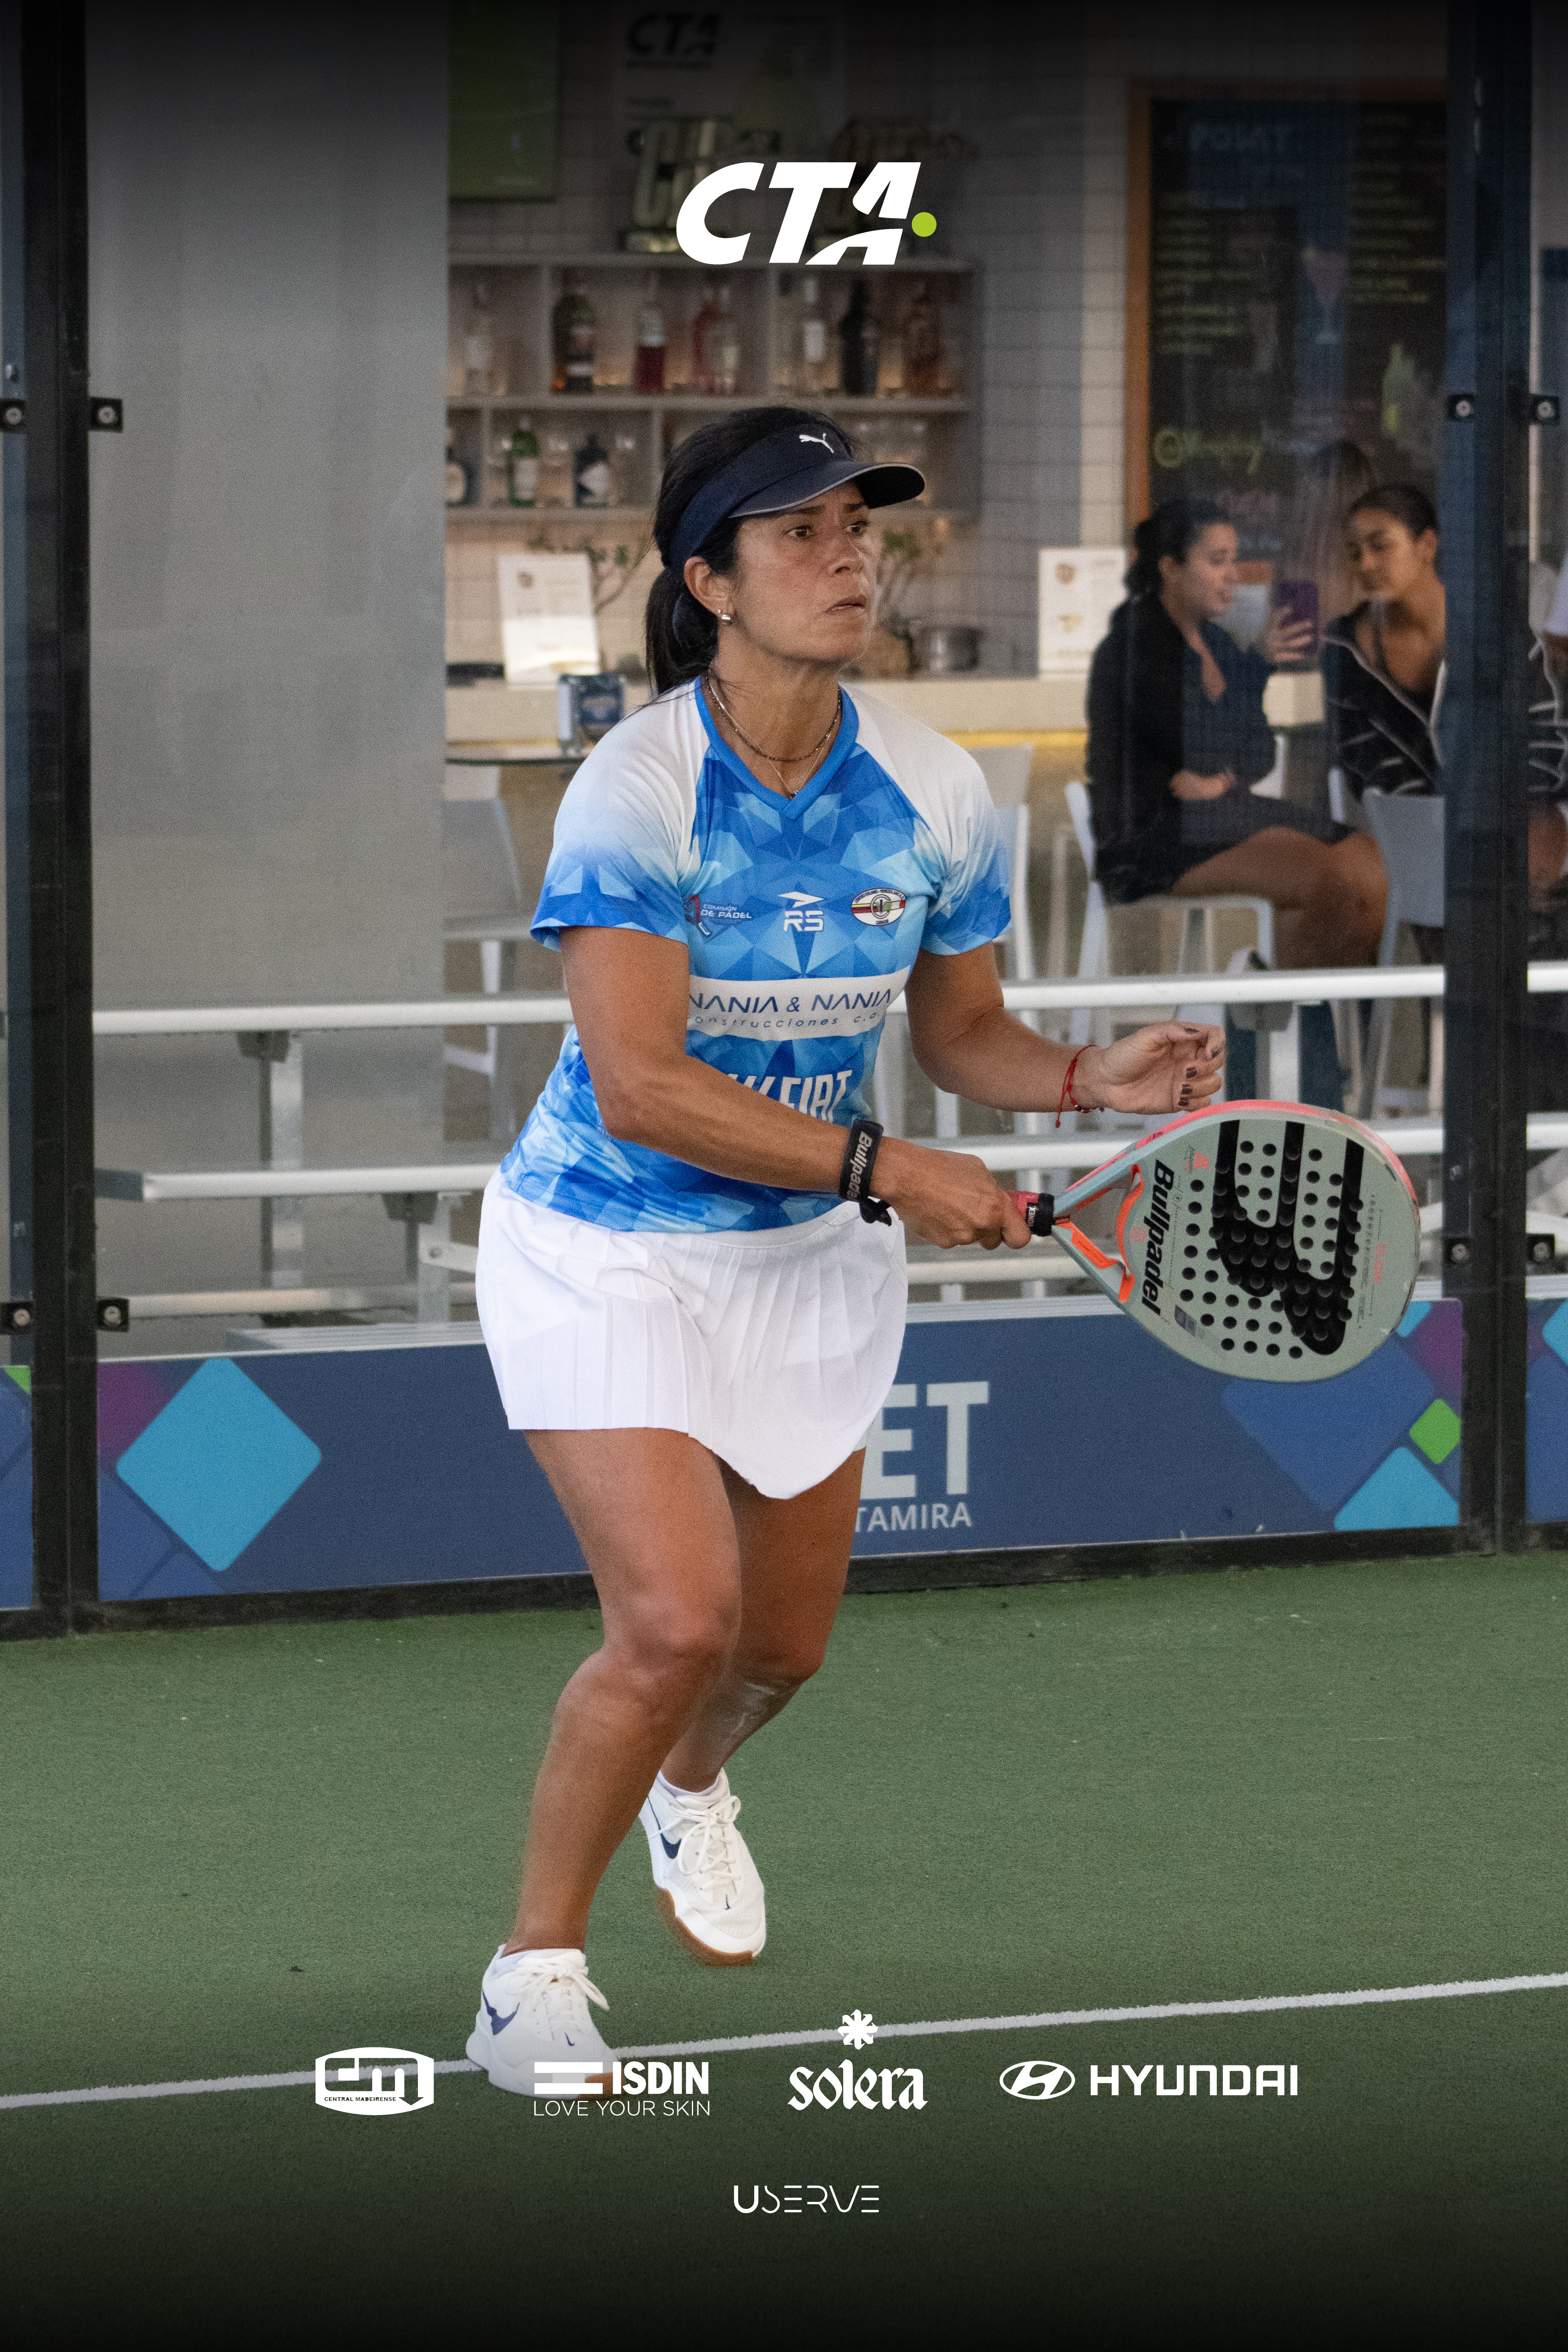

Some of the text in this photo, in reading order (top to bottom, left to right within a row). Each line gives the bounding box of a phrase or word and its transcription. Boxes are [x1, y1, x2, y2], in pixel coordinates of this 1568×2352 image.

[784, 911, 824, 931] RS
[786, 996, 800, 1013] &
[811, 989, 891, 1011] NANIA
[695, 1016, 839, 1028] onstrucciones
[847, 1131, 873, 1198] Bullpade
[1142, 1160, 1174, 1316] Bullpadel
[860, 1381, 989, 1500] ET
[854, 1502, 972, 1533] TAMIRA
